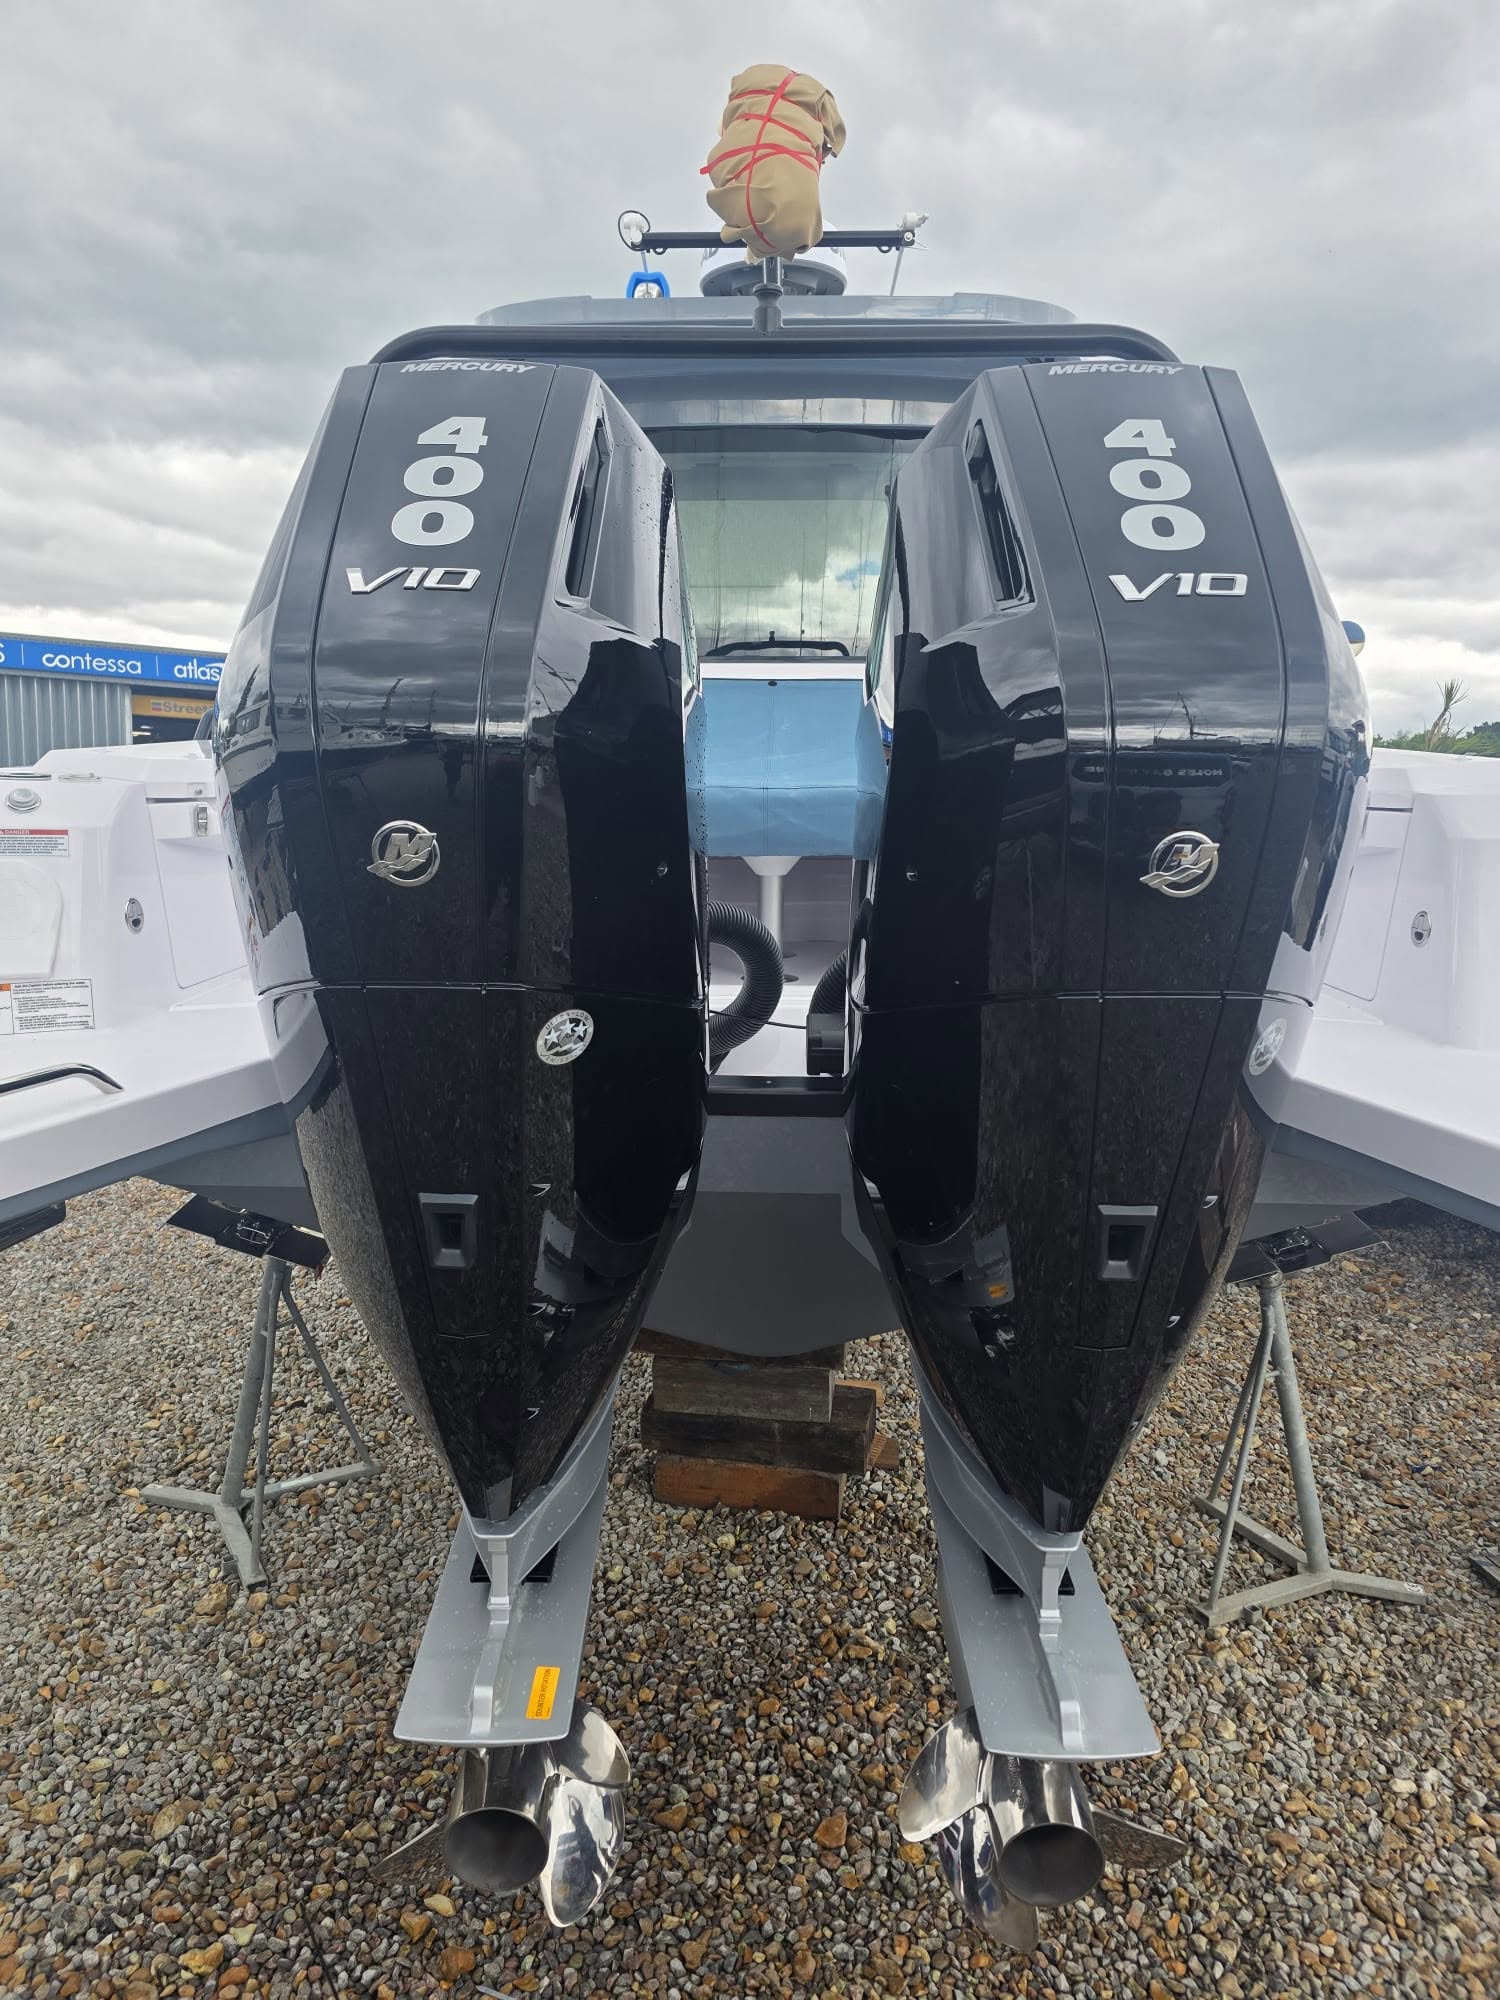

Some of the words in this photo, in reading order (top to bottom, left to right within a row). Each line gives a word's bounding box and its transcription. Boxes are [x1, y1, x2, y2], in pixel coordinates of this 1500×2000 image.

[400, 361, 537, 374] MERCURY
[1048, 363, 1184, 375] MERCURY
[391, 416, 488, 546] 400
[1103, 419, 1206, 551] 400
[345, 567, 481, 594] V10
[1108, 573, 1248, 602] V10
[42, 652, 142, 675] contessa
[173, 657, 221, 682] atlas
